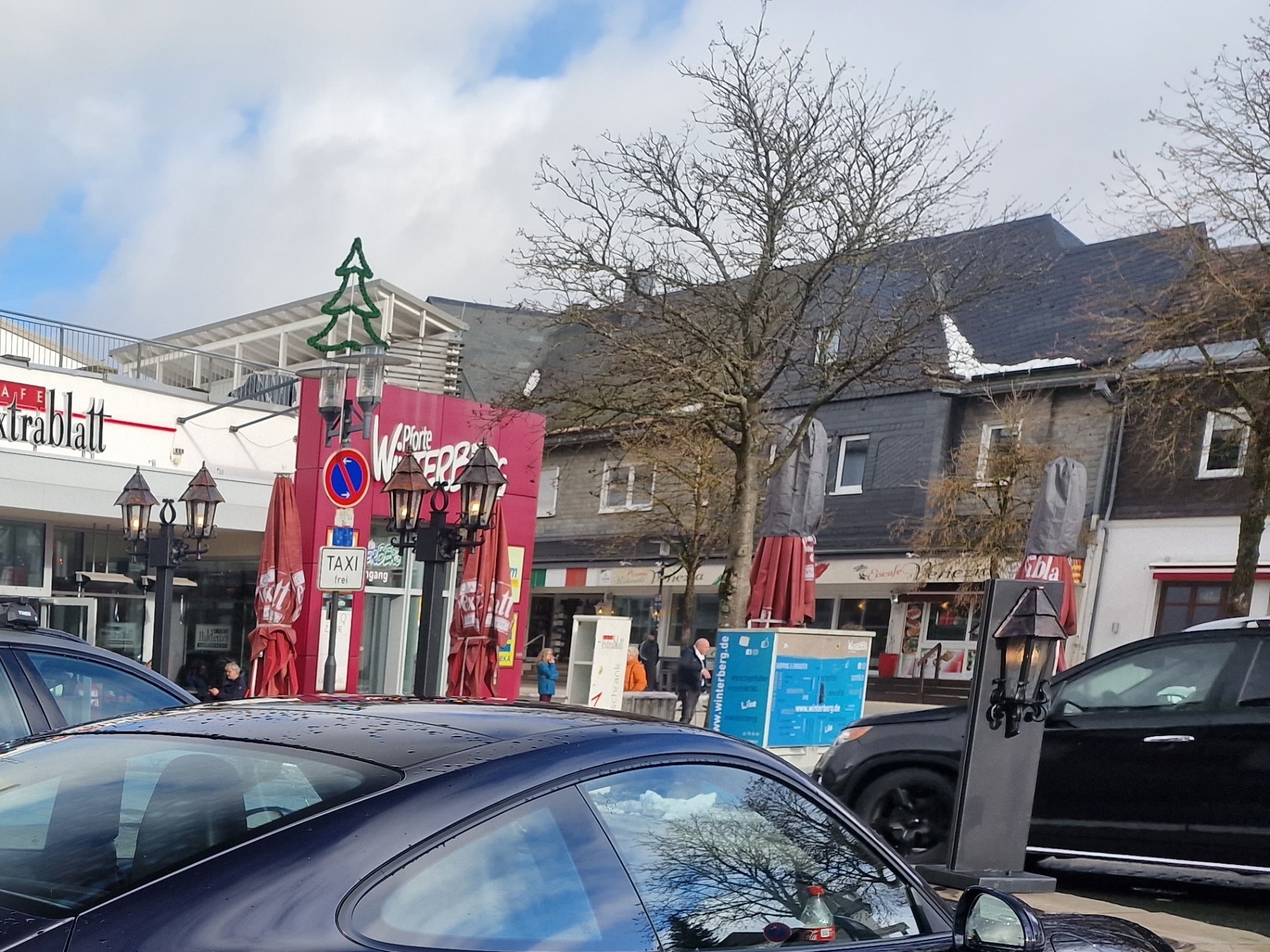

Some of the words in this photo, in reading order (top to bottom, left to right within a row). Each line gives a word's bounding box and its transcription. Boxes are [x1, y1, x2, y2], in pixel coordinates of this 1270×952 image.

[402, 425, 433, 452] Pforte
[327, 555, 358, 571] TAXI
[334, 575, 348, 584] frei
[366, 570, 388, 583] ngang
[712, 635, 730, 732] ww.winterberg.de
